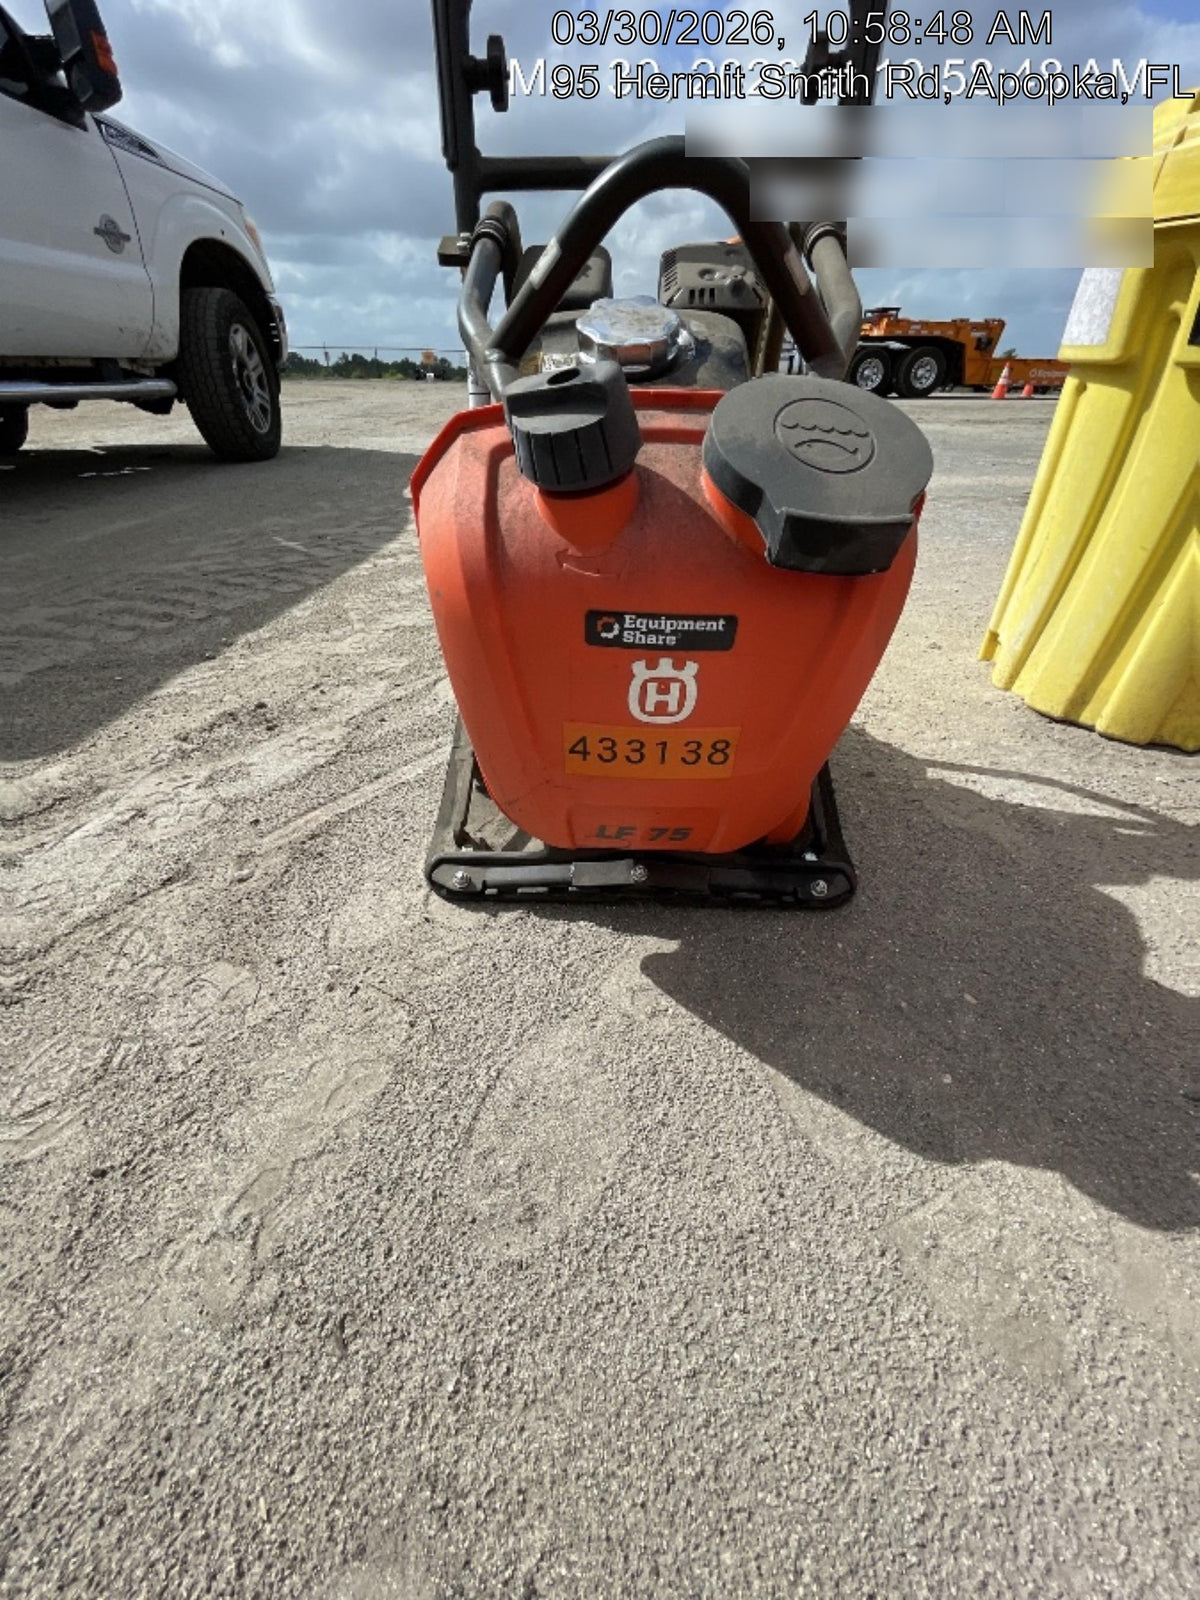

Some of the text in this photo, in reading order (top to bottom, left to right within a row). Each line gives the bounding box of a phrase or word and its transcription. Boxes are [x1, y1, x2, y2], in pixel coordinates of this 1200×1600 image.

[623, 614, 726, 633] Equipment
[622, 630, 678, 646] Share
[568, 735, 732, 766] 433138
[595, 824, 693, 841] LF 75
